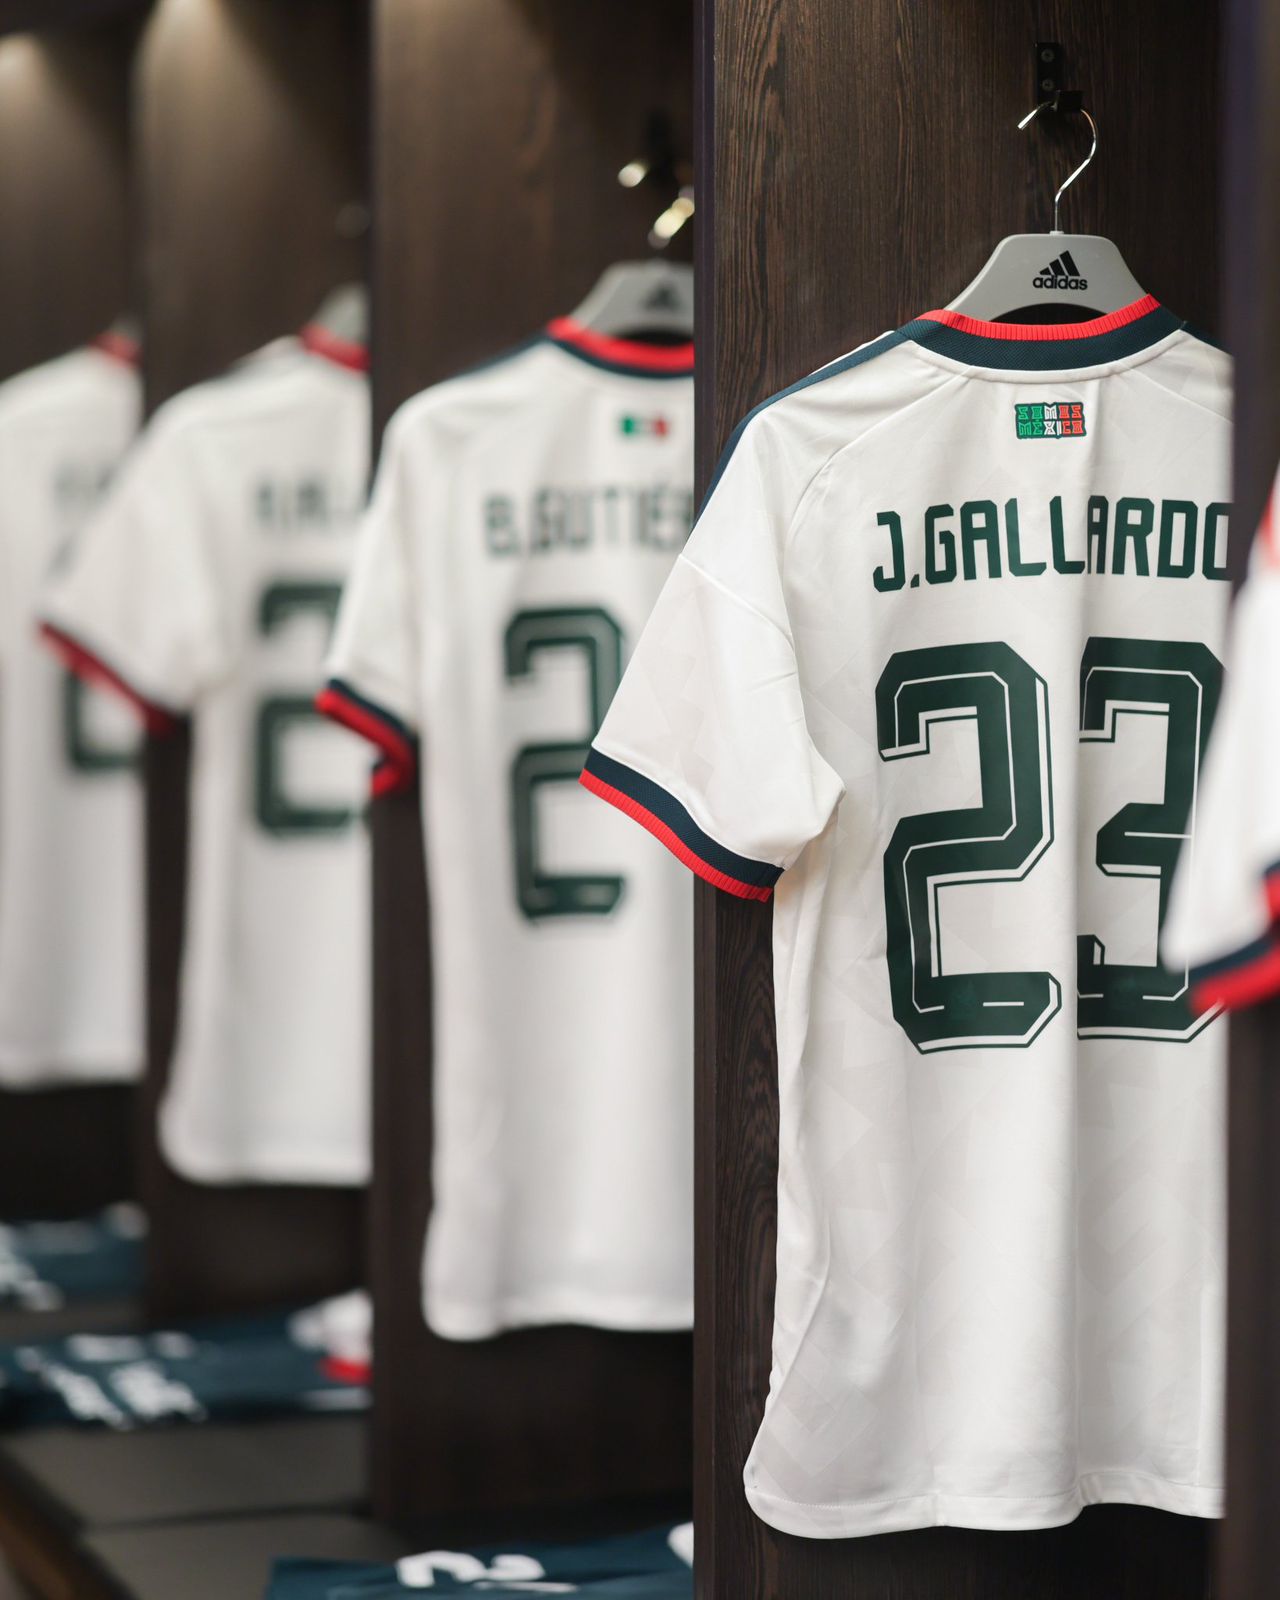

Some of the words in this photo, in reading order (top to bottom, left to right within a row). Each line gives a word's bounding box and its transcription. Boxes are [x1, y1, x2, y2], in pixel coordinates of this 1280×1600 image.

[1032, 275, 1088, 290] adidas
[1017, 404, 1083, 420] SOMOS
[873, 495, 1235, 592] J.GALLARDO
[875, 637, 1228, 1055] 23
